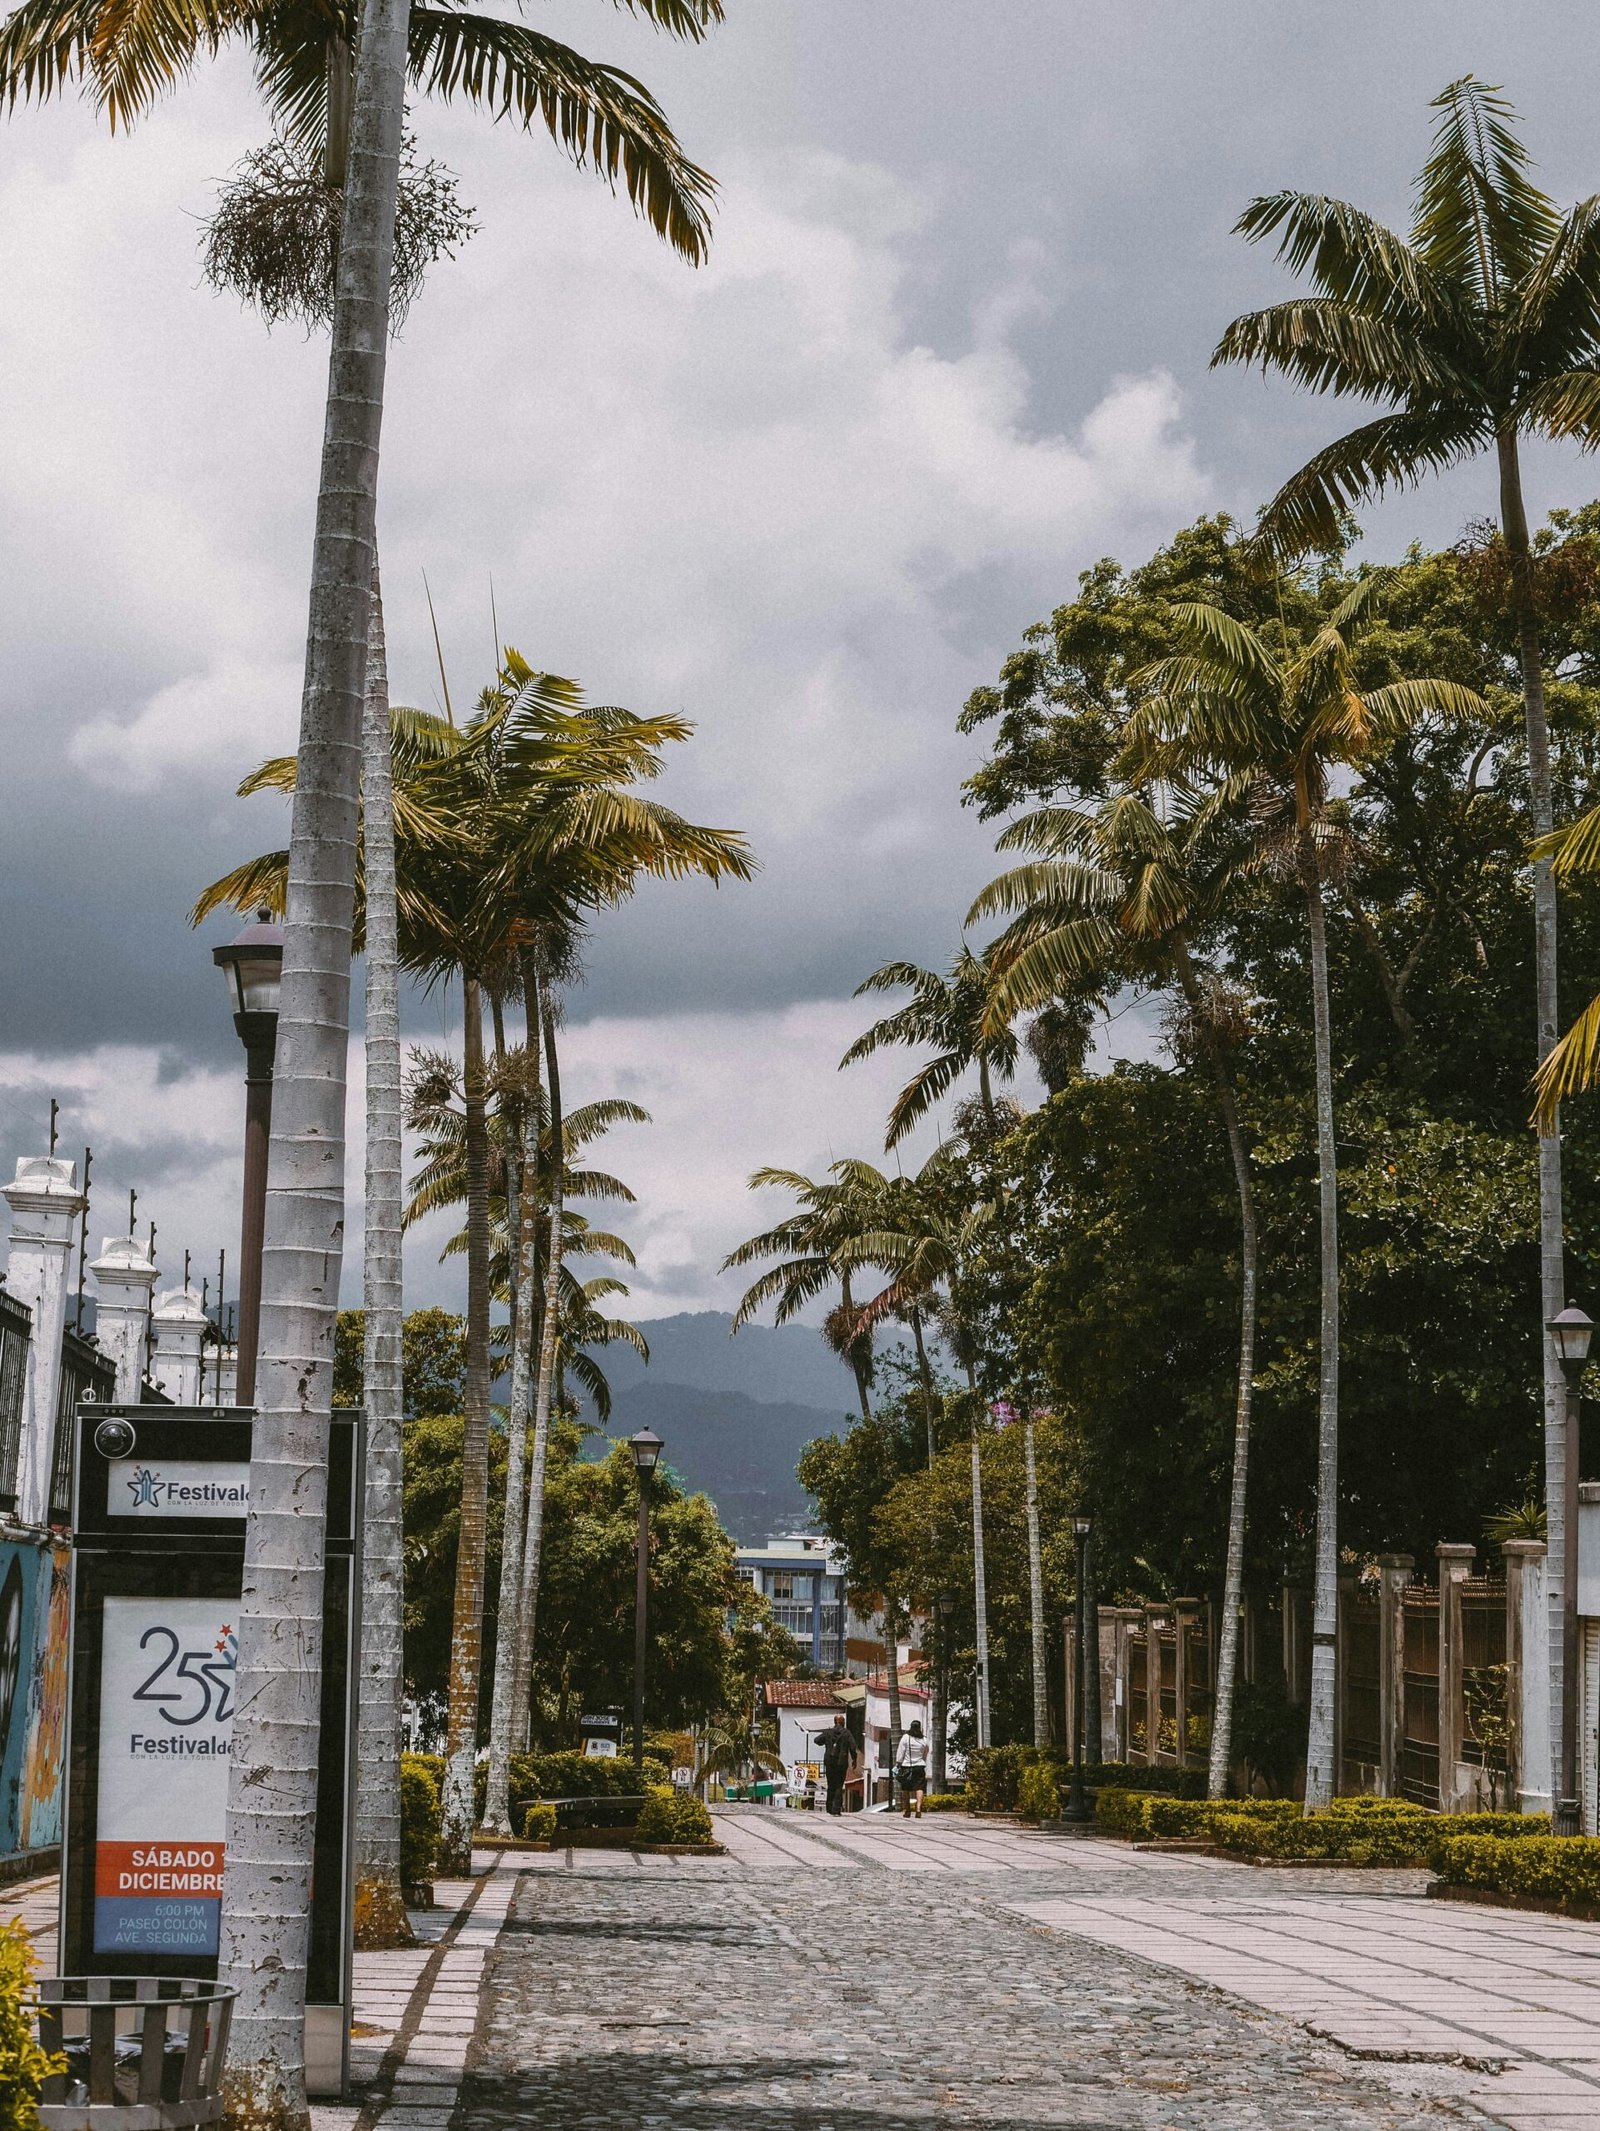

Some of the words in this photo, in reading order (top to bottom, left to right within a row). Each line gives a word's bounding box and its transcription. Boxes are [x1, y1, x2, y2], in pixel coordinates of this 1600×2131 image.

[133, 1626, 212, 1726] 25
[132, 1846, 215, 1868] SÁBADO
[155, 1905, 181, 1916] 6:00
[184, 1906, 204, 1916] PM
[119, 1918, 160, 1930] PASEO
[164, 1915, 207, 1931] COLÓN
[146, 1932, 207, 1944] SEGUNDA
